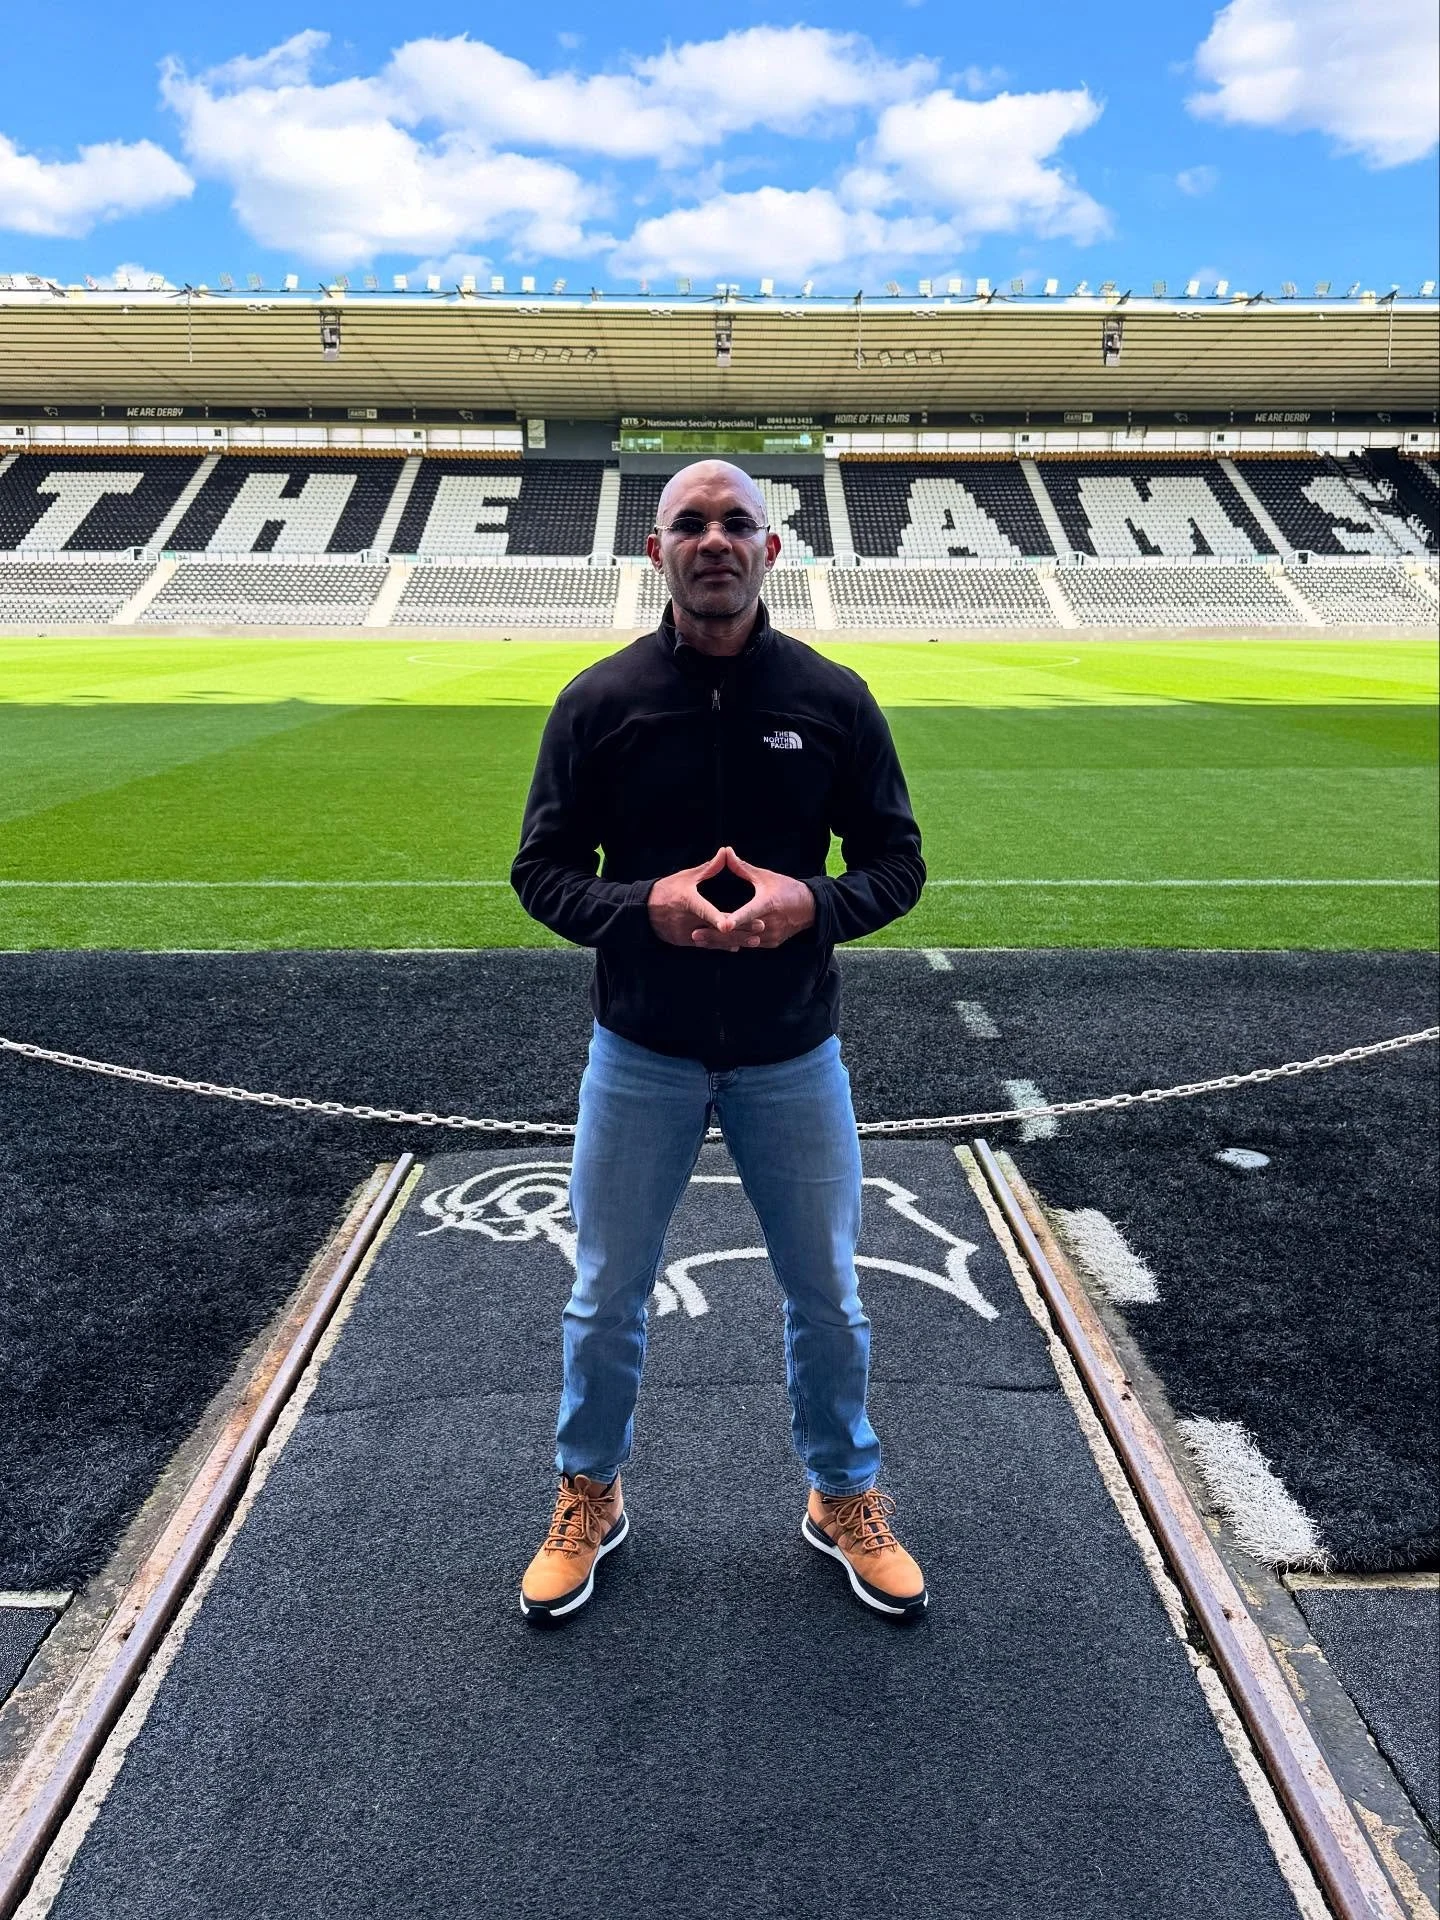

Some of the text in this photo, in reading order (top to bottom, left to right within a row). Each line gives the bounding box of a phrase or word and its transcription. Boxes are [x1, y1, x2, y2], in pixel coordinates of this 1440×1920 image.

[126, 407, 184, 417] WE ARE DERBY
[834, 413, 911, 424] HOME OF THE RAMS
[1254, 412, 1311, 423] WE ARE DERBY
[647, 419, 688, 427] Nationwide
[688, 419, 717, 429] Security
[717, 420, 754, 429] Specialists
[16, 471, 522, 557] THE
[770, 742, 790, 750] FACE
